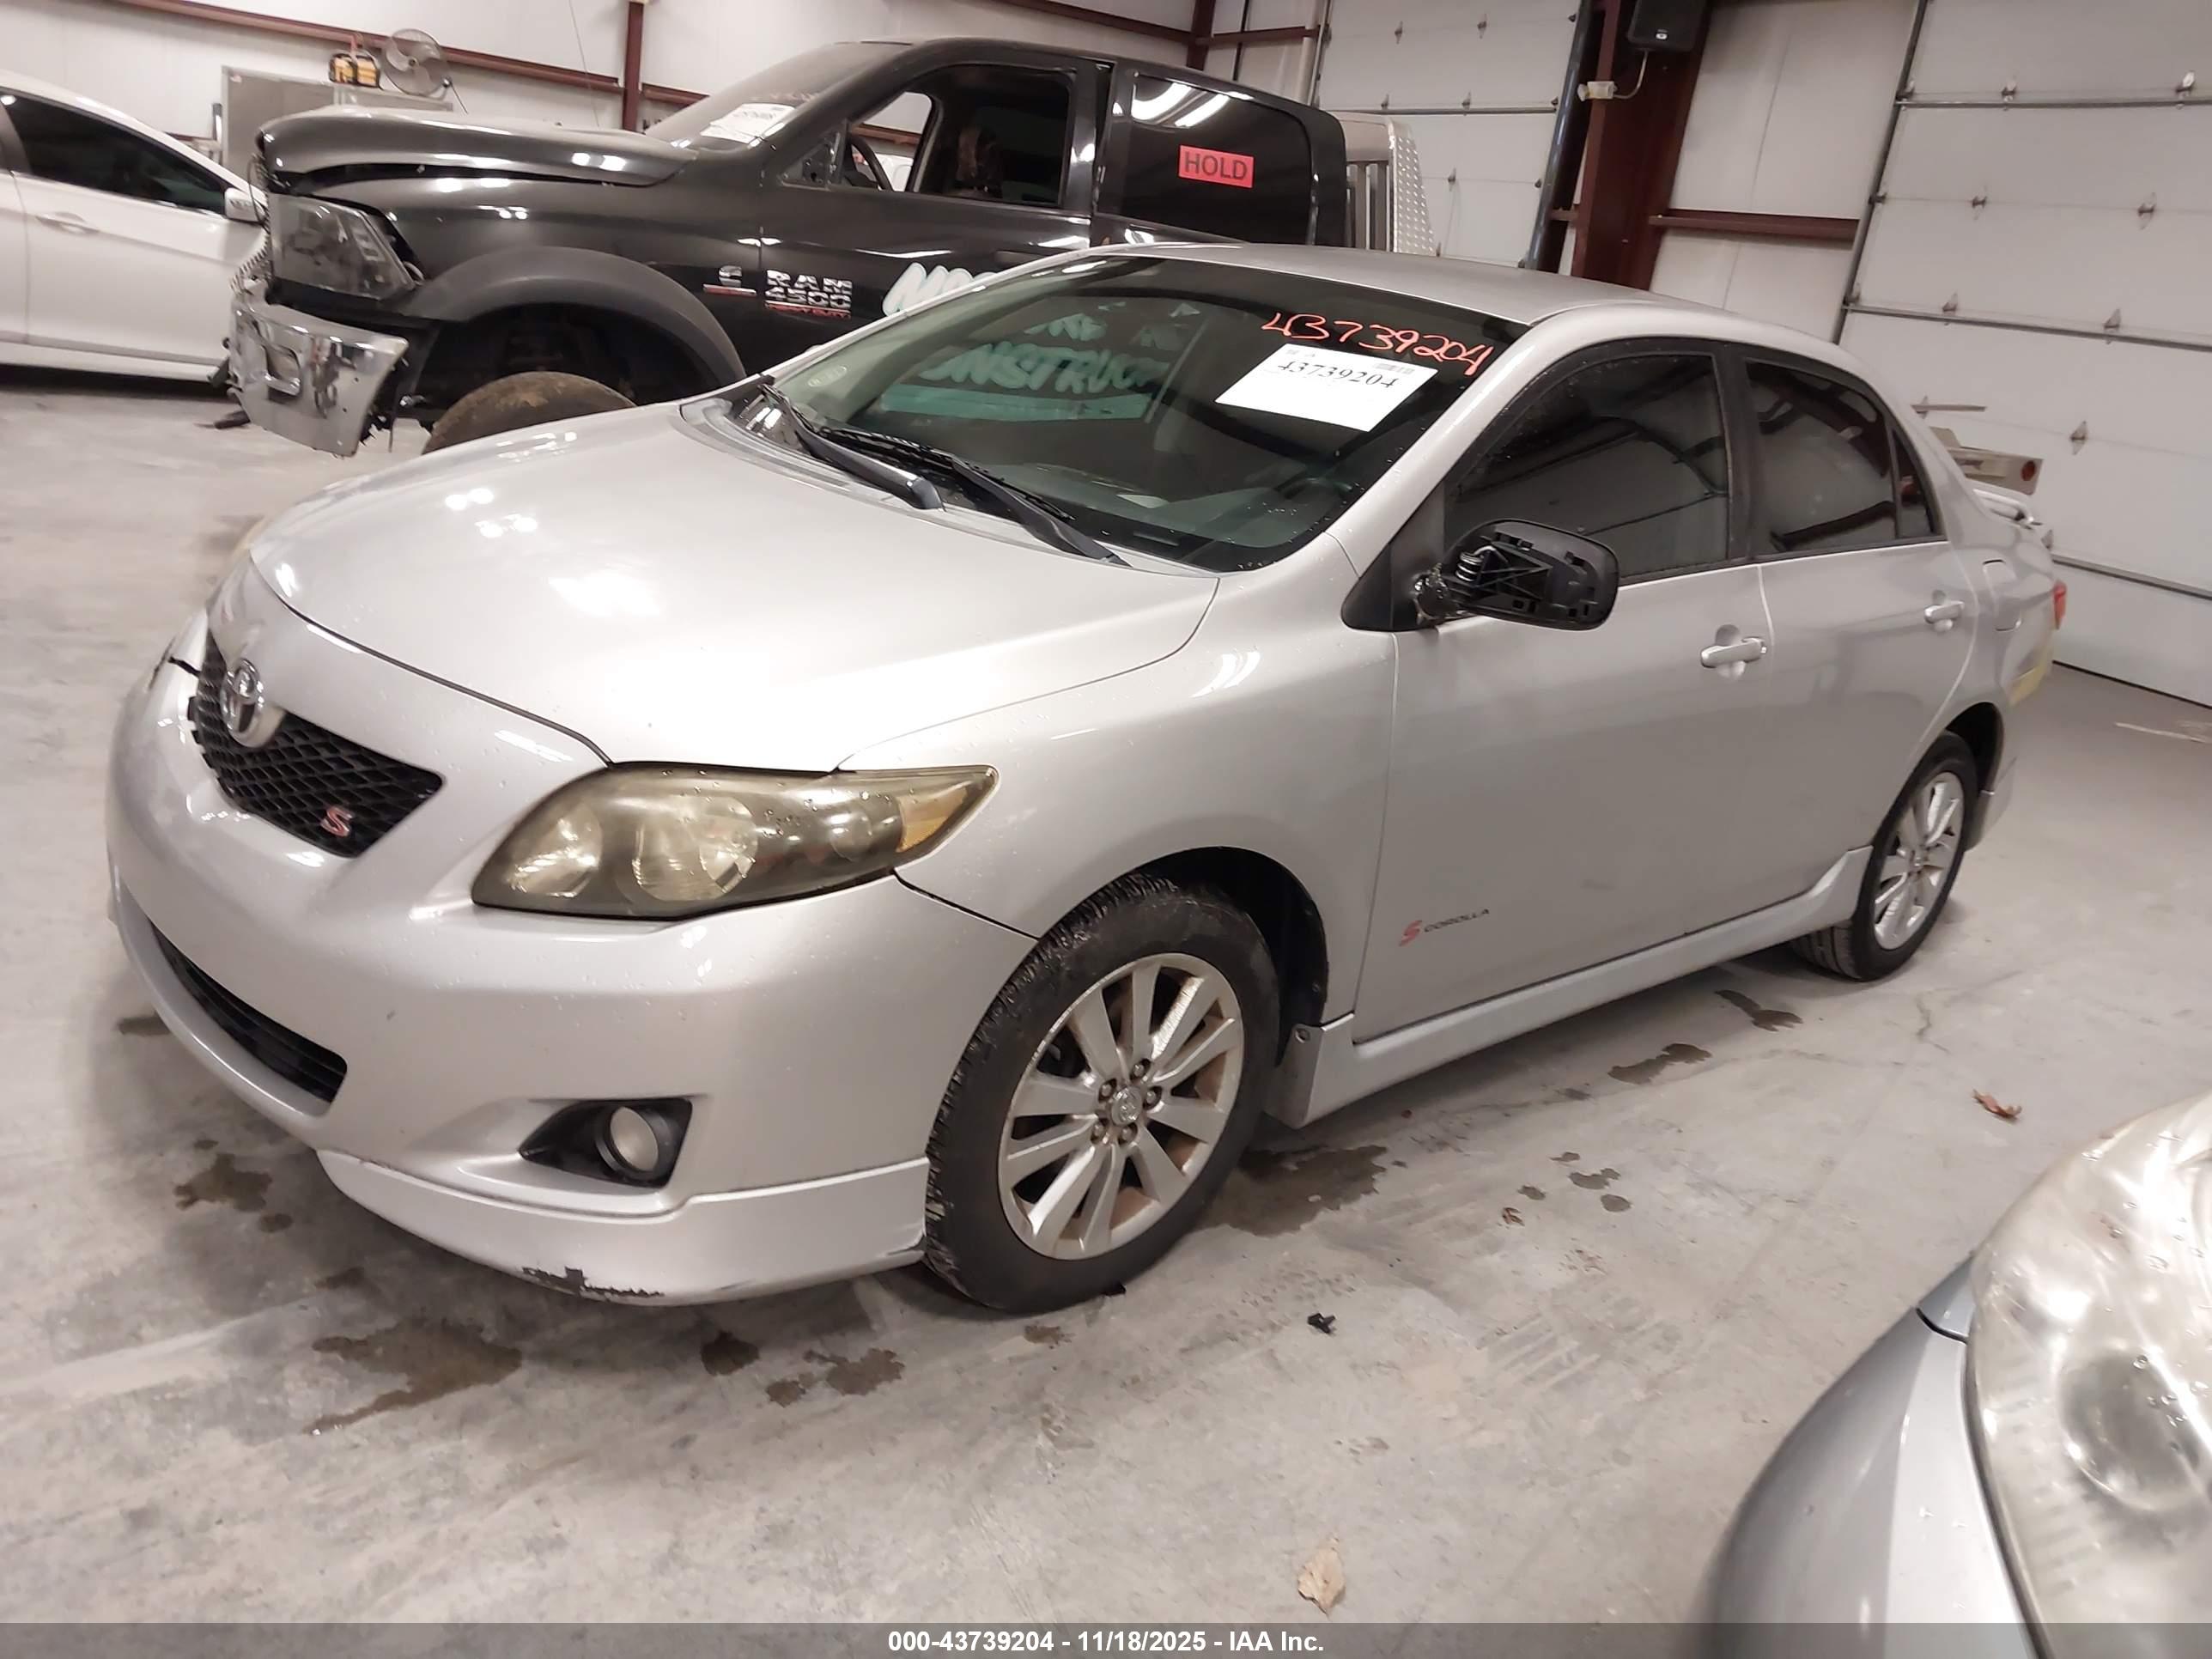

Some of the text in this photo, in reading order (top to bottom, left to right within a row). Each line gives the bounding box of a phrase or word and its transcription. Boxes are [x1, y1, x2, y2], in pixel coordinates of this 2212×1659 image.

[1184, 151, 1248, 180] HOLD
[766, 269, 854, 295] RAM
[764, 285, 853, 309] 4500
[1261, 312, 1494, 376] 43739204
[1277, 360, 1401, 389] 43739204
[319, 805, 353, 837] S
